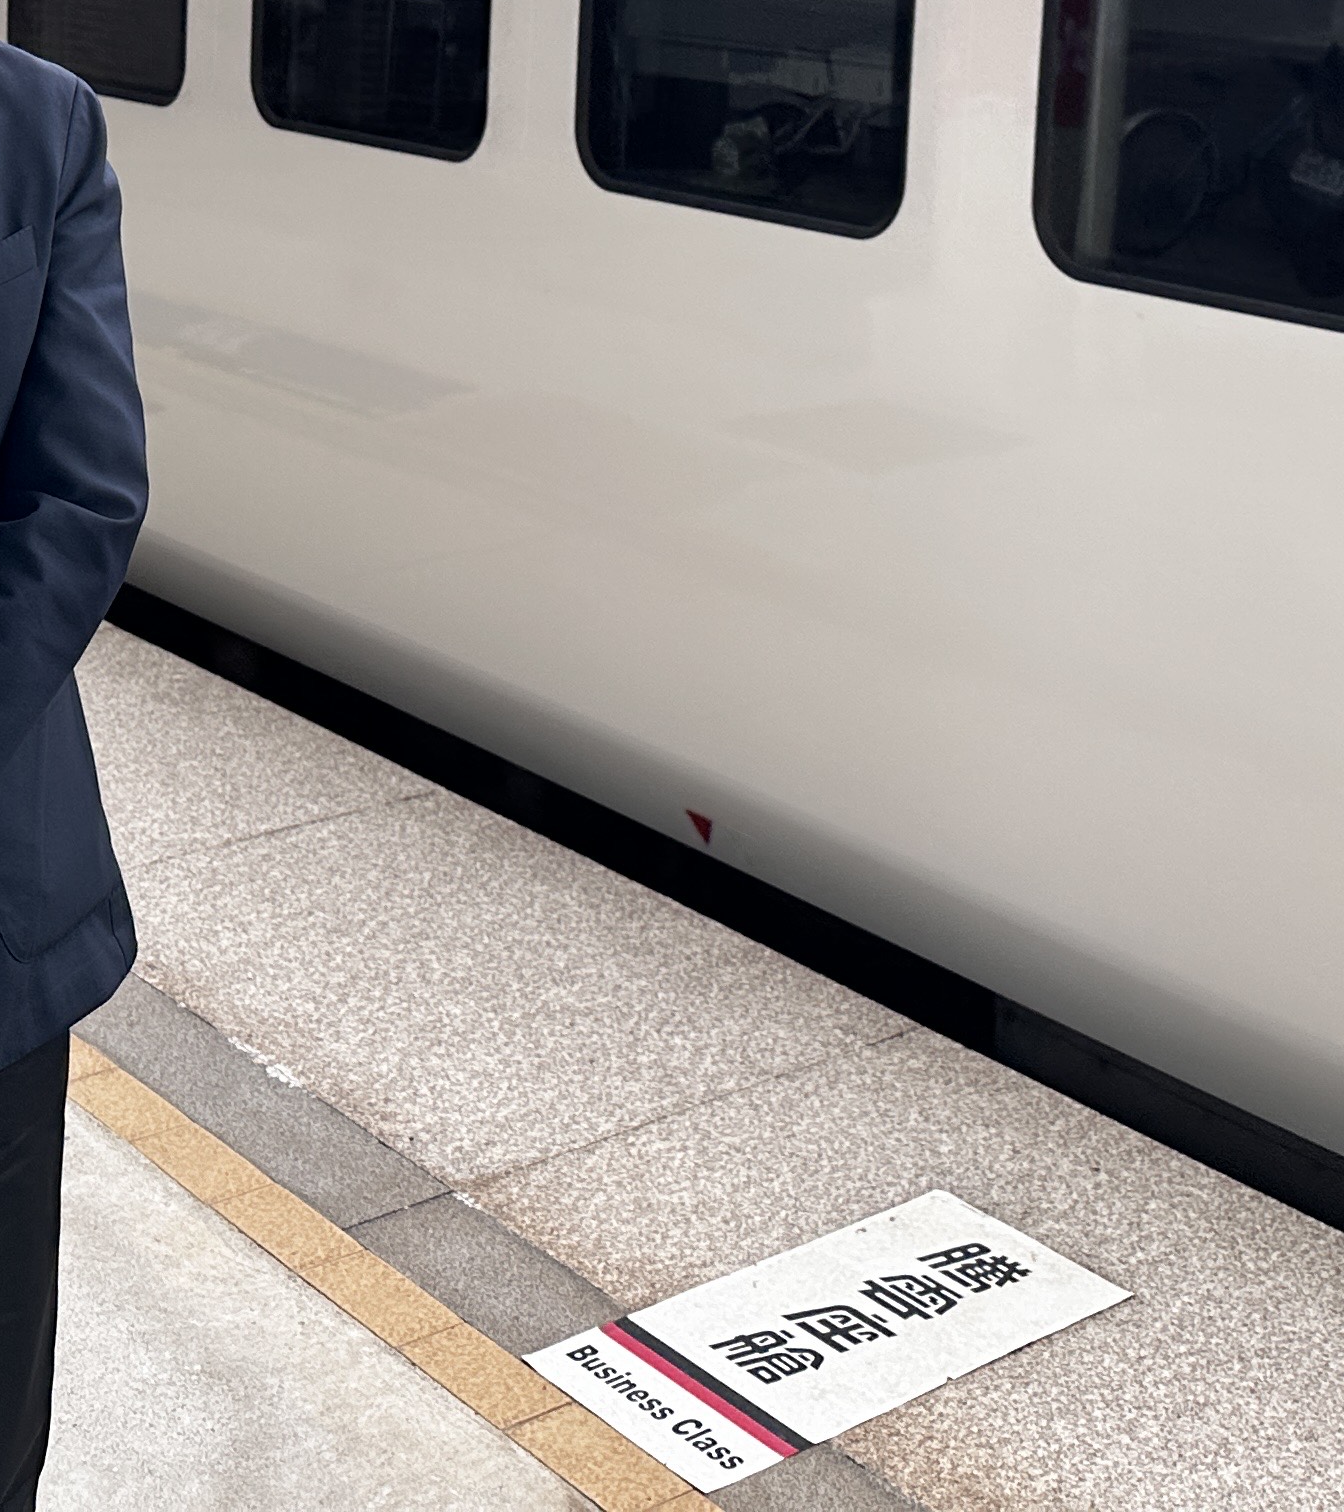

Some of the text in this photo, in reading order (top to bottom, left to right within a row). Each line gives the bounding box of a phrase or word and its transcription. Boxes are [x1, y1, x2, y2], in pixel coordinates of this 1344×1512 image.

[709, 1242, 1033, 1384] 騰雲座艙
[566, 1344, 744, 1470] Business Class
